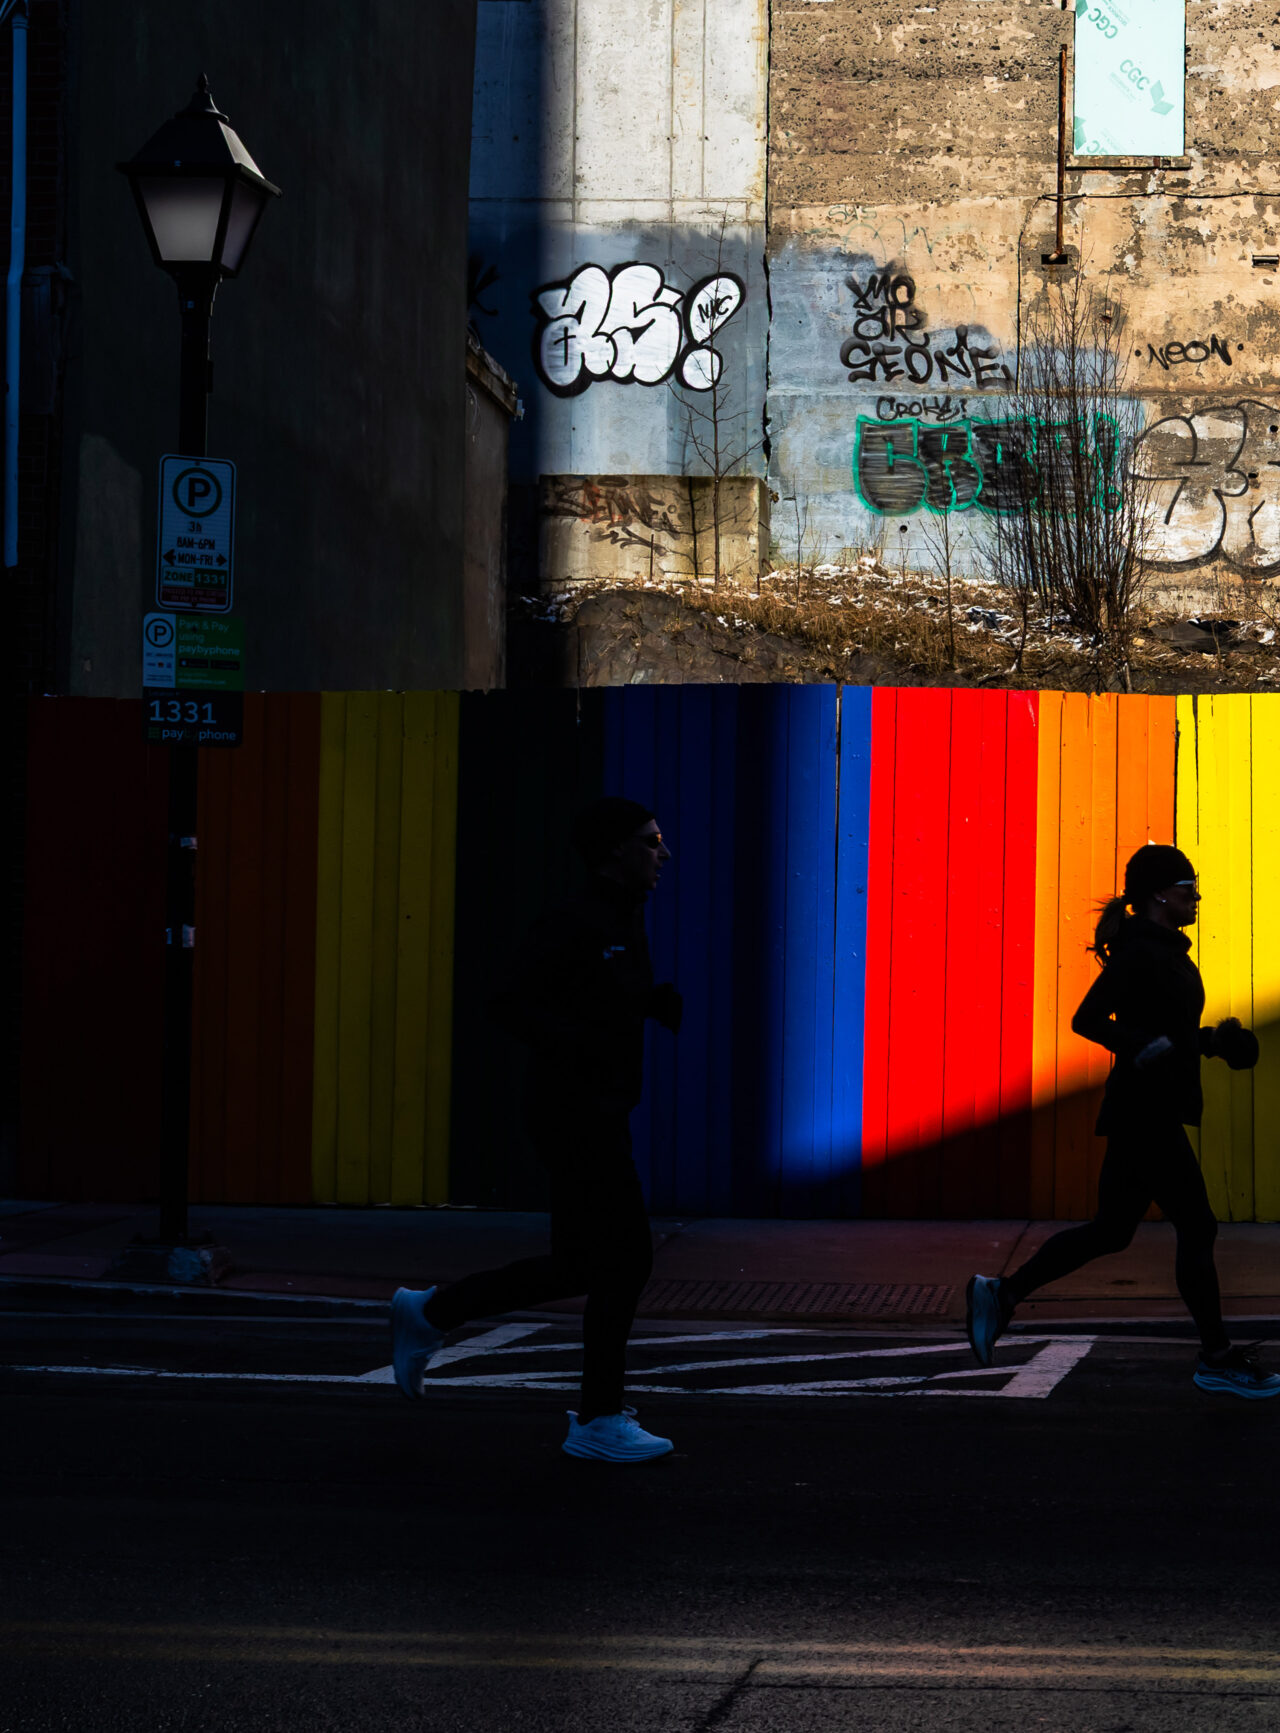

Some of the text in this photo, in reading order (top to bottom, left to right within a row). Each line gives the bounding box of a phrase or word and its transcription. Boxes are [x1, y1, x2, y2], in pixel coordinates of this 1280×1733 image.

[1088, 8, 1118, 39] CGC
[1120, 59, 1150, 90] CGC
[188, 477, 211, 507] P
[178, 552, 213, 566] MON-FRI
[165, 571, 225, 585] ZONE 1331
[154, 625, 167, 642] P
[212, 621, 230, 632] Pay
[149, 699, 217, 725] 1331
[162, 729, 184, 740] pay
[198, 729, 237, 742] phone
